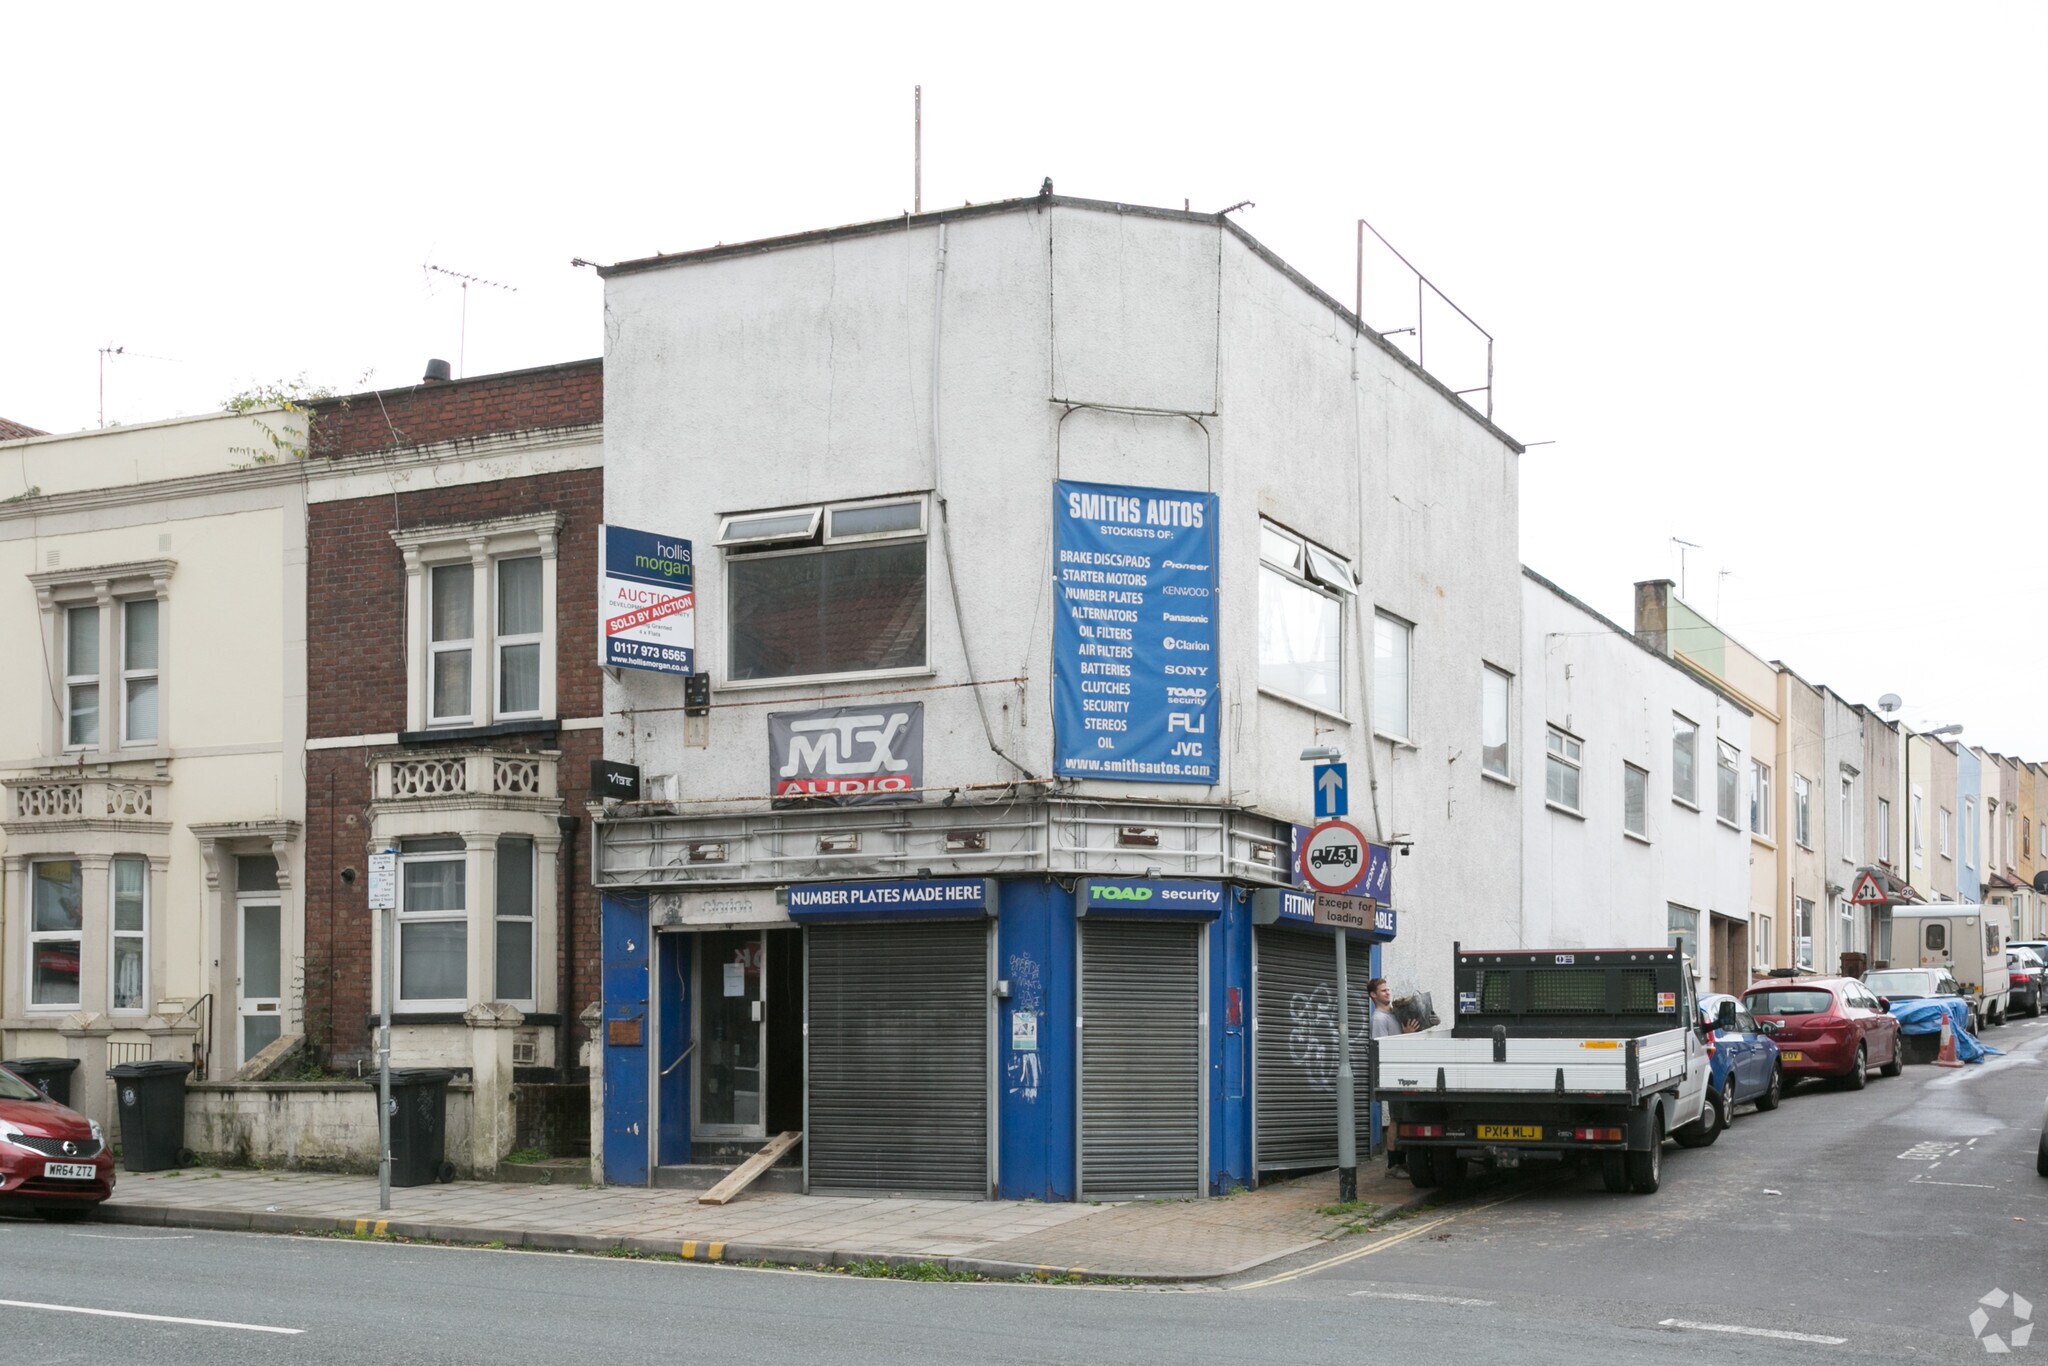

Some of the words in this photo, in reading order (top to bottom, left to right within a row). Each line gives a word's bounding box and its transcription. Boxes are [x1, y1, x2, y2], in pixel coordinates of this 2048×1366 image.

[1070, 492, 1140, 524] SMITHS
[1146, 499, 1204, 528] AUTOS
[1100, 526, 1155, 539] STOCKISTS
[1157, 530, 1174, 540] OF:
[657, 541, 691, 562] hollis
[635, 554, 690, 576] morgan
[1060, 550, 1092, 564] BRAKE
[1094, 553, 1151, 569] DISCS/PADS
[1162, 560, 1209, 571] Pioneer
[1063, 568, 1105, 583] STARTER
[1106, 572, 1147, 586] MOTORS
[618, 587, 676, 604] AUCTIO
[1065, 587, 1107, 602] NUMBER
[1108, 590, 1143, 604] PLATES
[1162, 586, 1209, 597] KENWOOD
[610, 615, 636, 631] SOLD
[636, 609, 650, 622] BY
[652, 596, 693, 618] AUCTION
[1072, 606, 1138, 622] ALTERNATORS
[1163, 612, 1209, 624] Panasonic
[1079, 625, 1095, 638] OIL
[1096, 626, 1133, 640] FILTERS
[614, 642, 639, 655] 0117
[640, 645, 660, 658] 973
[662, 649, 686, 662] 6565
[1078, 643, 1095, 656] AIR
[1096, 644, 1133, 659] FILTERS
[1176, 639, 1210, 650] Clarion
[611, 655, 690, 672] www.hollismorgan.co.uk
[1080, 662, 1131, 677] BATTERIES
[1164, 665, 1208, 676] SONY
[1081, 680, 1131, 695] CLUTCHES
[1166, 687, 1207, 698] TOAD
[1083, 699, 1130, 713] SECURITY
[1168, 696, 1206, 706] security
[1084, 717, 1127, 731] STEREOS
[1097, 736, 1115, 749] OIL
[1171, 741, 1202, 756] JVC
[1065, 758, 1210, 776] www.smithsautos.com
[783, 778, 906, 797] AUDIO
[1326, 847, 1357, 861] 7.5T
[790, 891, 849, 906] NUMBER
[850, 889, 900, 904] PLATES
[902, 887, 943, 902] MADE
[945, 886, 982, 900] HERE
[1090, 886, 1153, 901] TOAD
[1161, 889, 1220, 903] security
[1318, 896, 1353, 910] Except
[1358, 901, 1372, 911] for
[1327, 911, 1363, 926] loading
[1375, 910, 1393, 930] ABLE
[1484, 1126, 1509, 1138] PX14
[1512, 1127, 1535, 1138] MLJ
[49, 1164, 74, 1176] WR64
[76, 1166, 93, 1177] ZTZ
